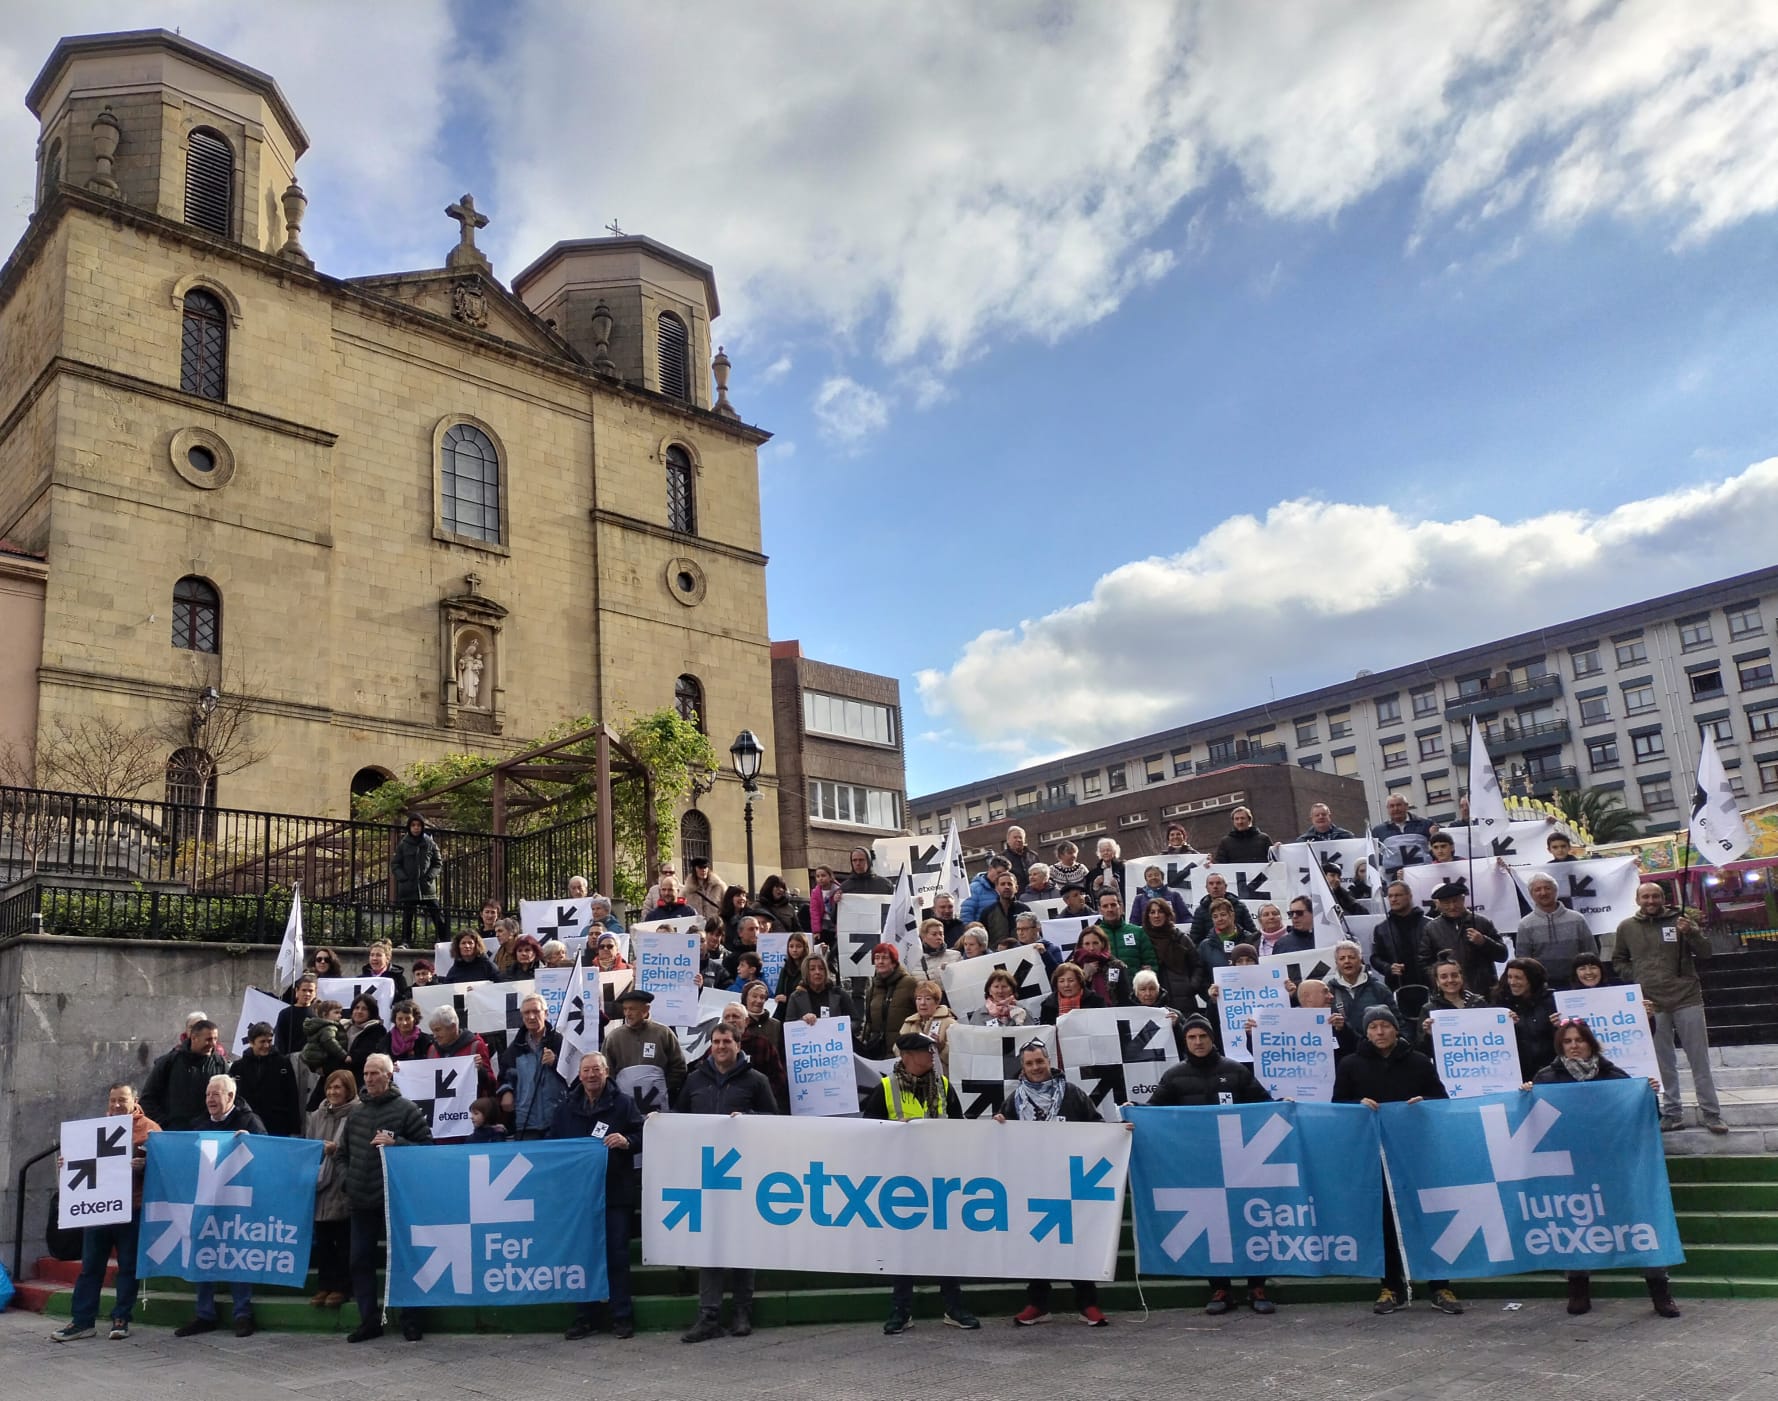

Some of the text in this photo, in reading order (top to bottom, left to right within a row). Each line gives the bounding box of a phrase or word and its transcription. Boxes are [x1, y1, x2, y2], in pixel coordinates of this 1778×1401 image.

[642, 953, 690, 967] Ezin da
[642, 967, 693, 982] gehiago
[1223, 986, 1279, 1001] Ezin da
[1612, 1010, 1636, 1026] da
[1261, 1032, 1322, 1047] Ezin da
[1441, 1031, 1505, 1047] Ezin da
[1592, 1028, 1643, 1046] hiago
[792, 1038, 843, 1055] Ezin da
[793, 1054, 848, 1073] gehiago
[1261, 1048, 1328, 1066] gehiago
[1443, 1048, 1512, 1067] gehiago
[1132, 1083, 1159, 1095] etxe
[438, 1111, 469, 1121] etxera
[755, 1161, 1009, 1232] etxera
[70, 1199, 123, 1216] etxera
[1243, 1195, 1317, 1228] Gari
[198, 1213, 298, 1244] Arkaitz
[1524, 1220, 1659, 1255] etxera
[485, 1232, 534, 1260] Fer
[1245, 1230, 1357, 1262] etxera
[195, 1246, 295, 1273] etxera
[483, 1262, 586, 1292] etxera
